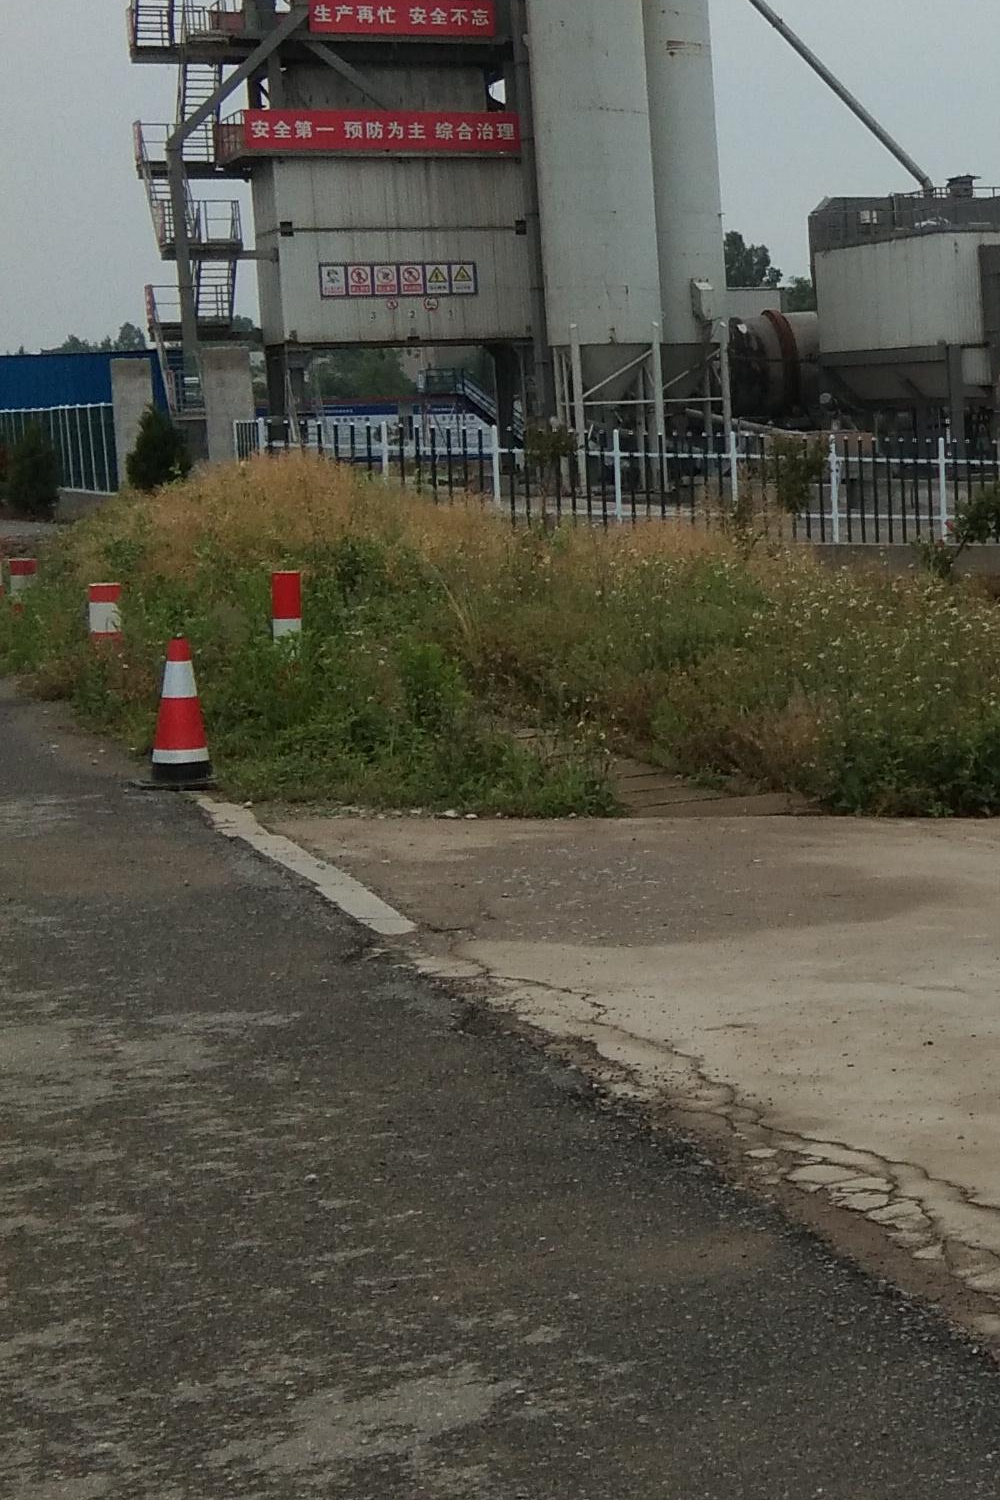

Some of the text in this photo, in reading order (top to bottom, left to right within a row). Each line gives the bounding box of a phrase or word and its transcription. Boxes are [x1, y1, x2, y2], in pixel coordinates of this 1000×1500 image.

[314, 3, 489, 27] 生产再忙 安全不忘
[250, 120, 515, 141] 安全第一 预防为主 综合治理
